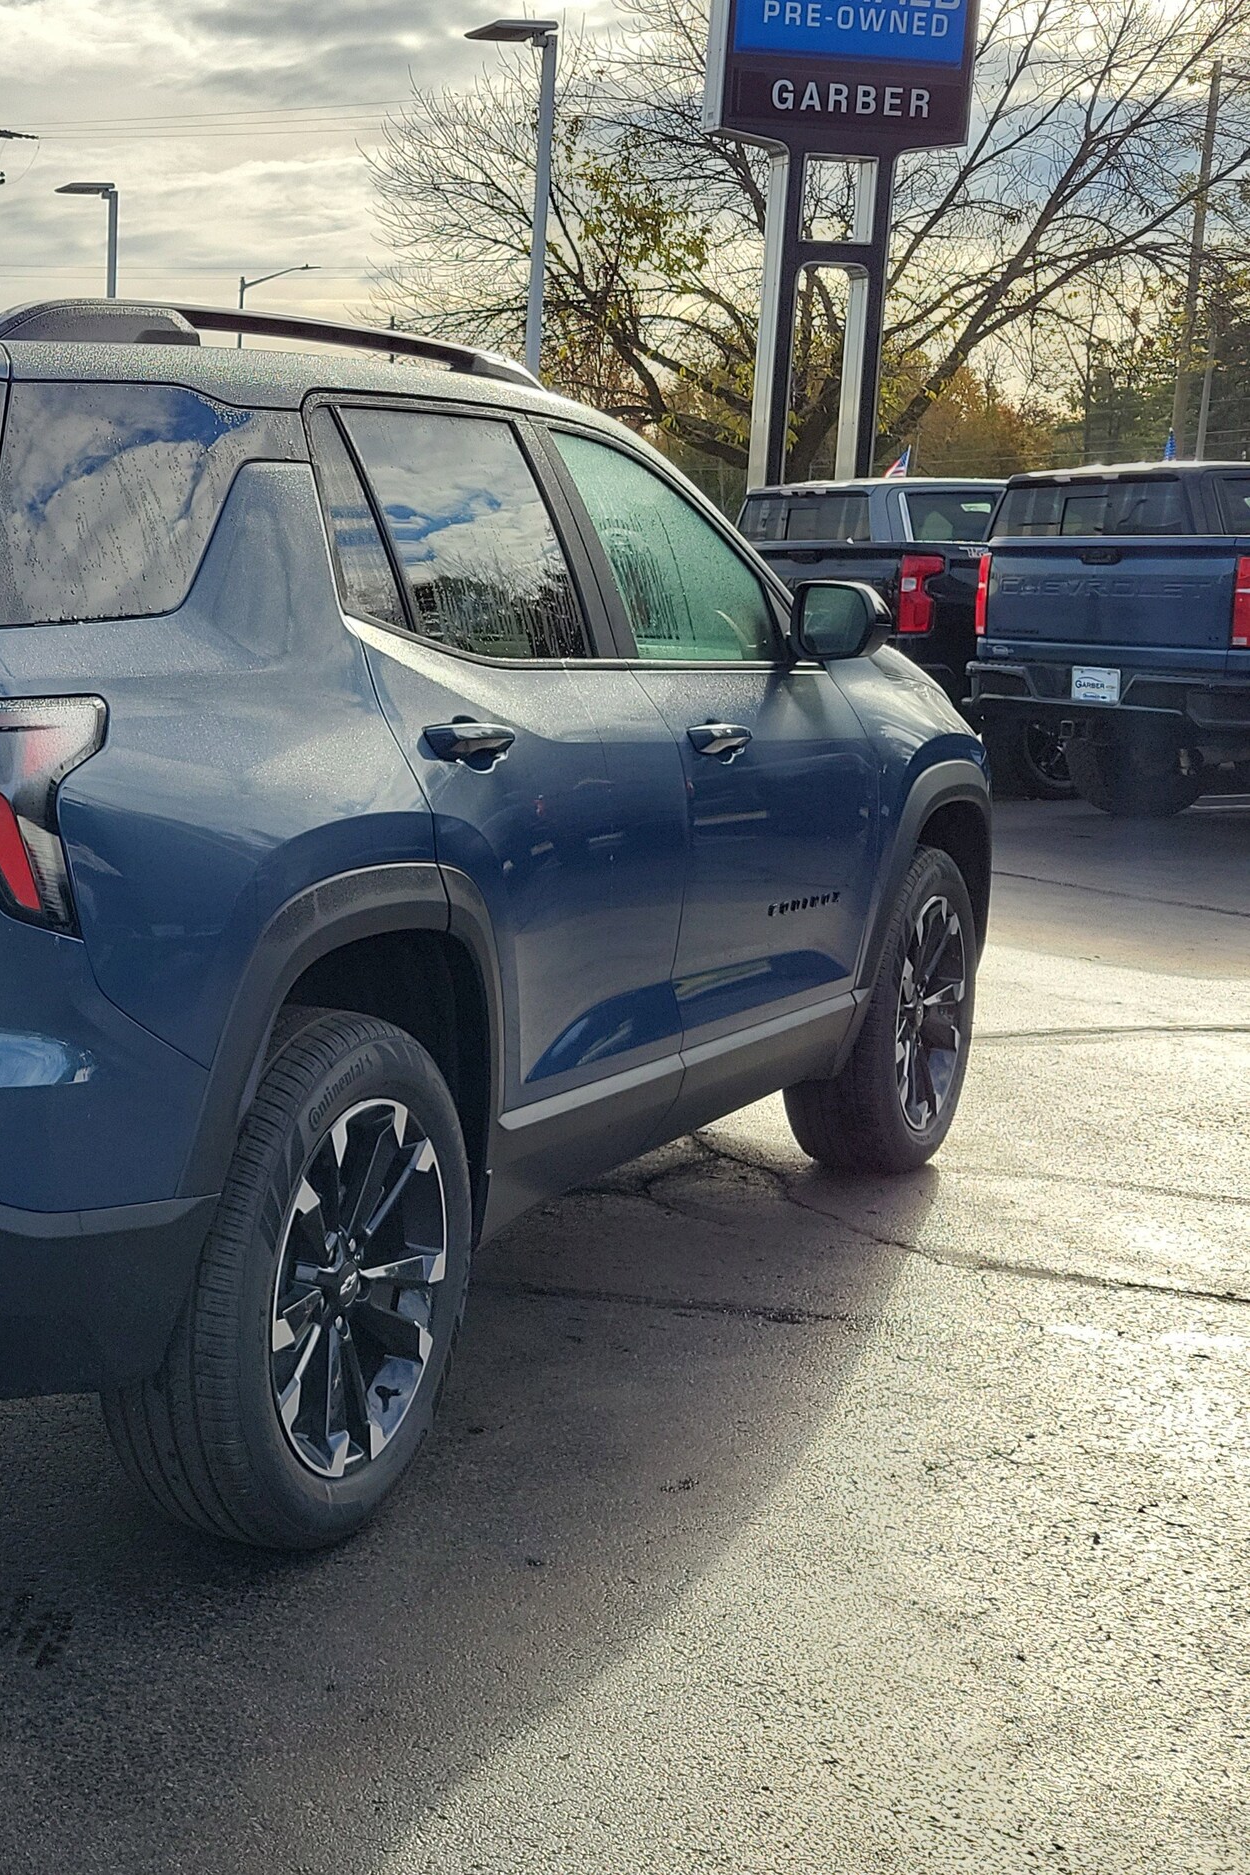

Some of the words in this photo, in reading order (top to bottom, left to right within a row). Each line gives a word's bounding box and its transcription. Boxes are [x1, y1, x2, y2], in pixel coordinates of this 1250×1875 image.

[762, 0, 949, 38] PRE-OWNED
[771, 79, 931, 119] GARBER
[1000, 575, 1213, 600] CHEVROLET
[1075, 680, 1105, 689] GARBER
[308, 1056, 366, 1133] Continental
